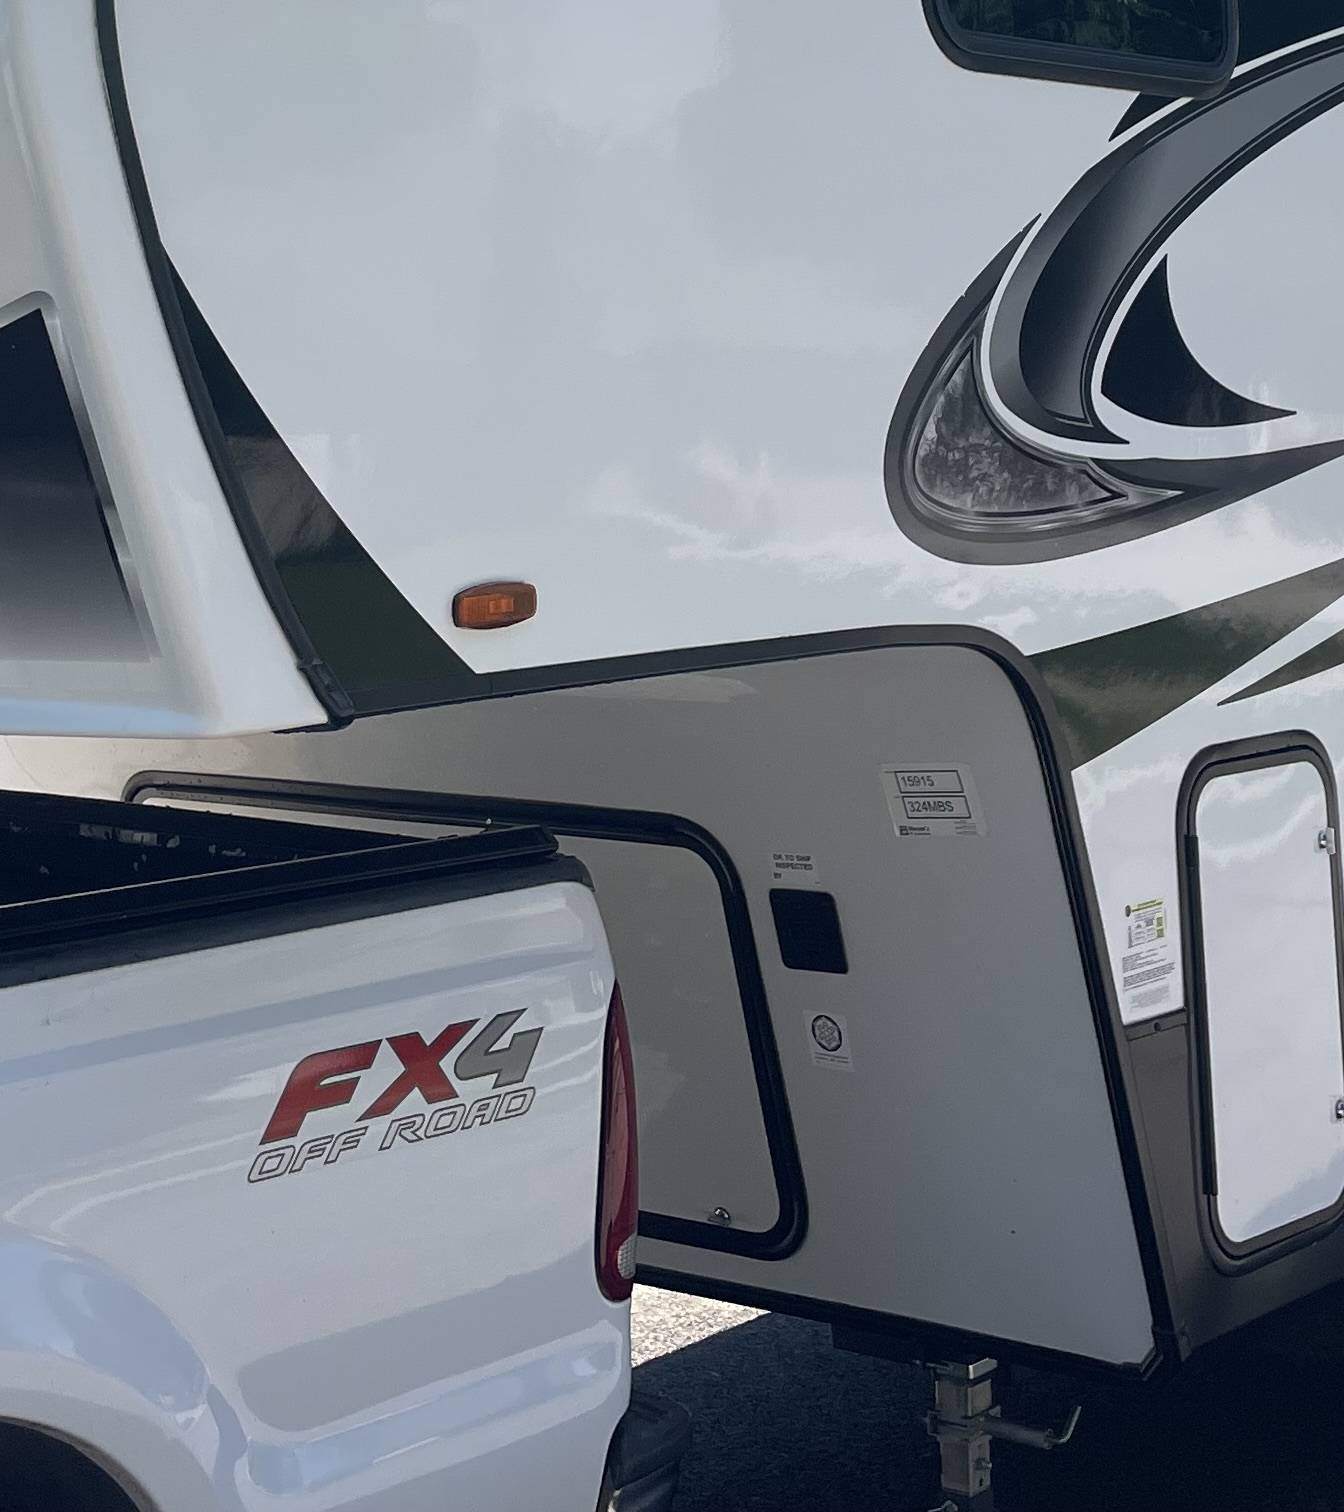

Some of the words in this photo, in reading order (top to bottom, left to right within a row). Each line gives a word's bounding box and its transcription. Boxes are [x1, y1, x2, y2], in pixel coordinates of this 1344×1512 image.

[900, 775, 935, 787] 15915
[907, 800, 954, 813] 324MBS
[259, 1007, 544, 1146] FX4
[247, 1125, 369, 1184] OFF
[378, 1086, 537, 1152] ROAD
